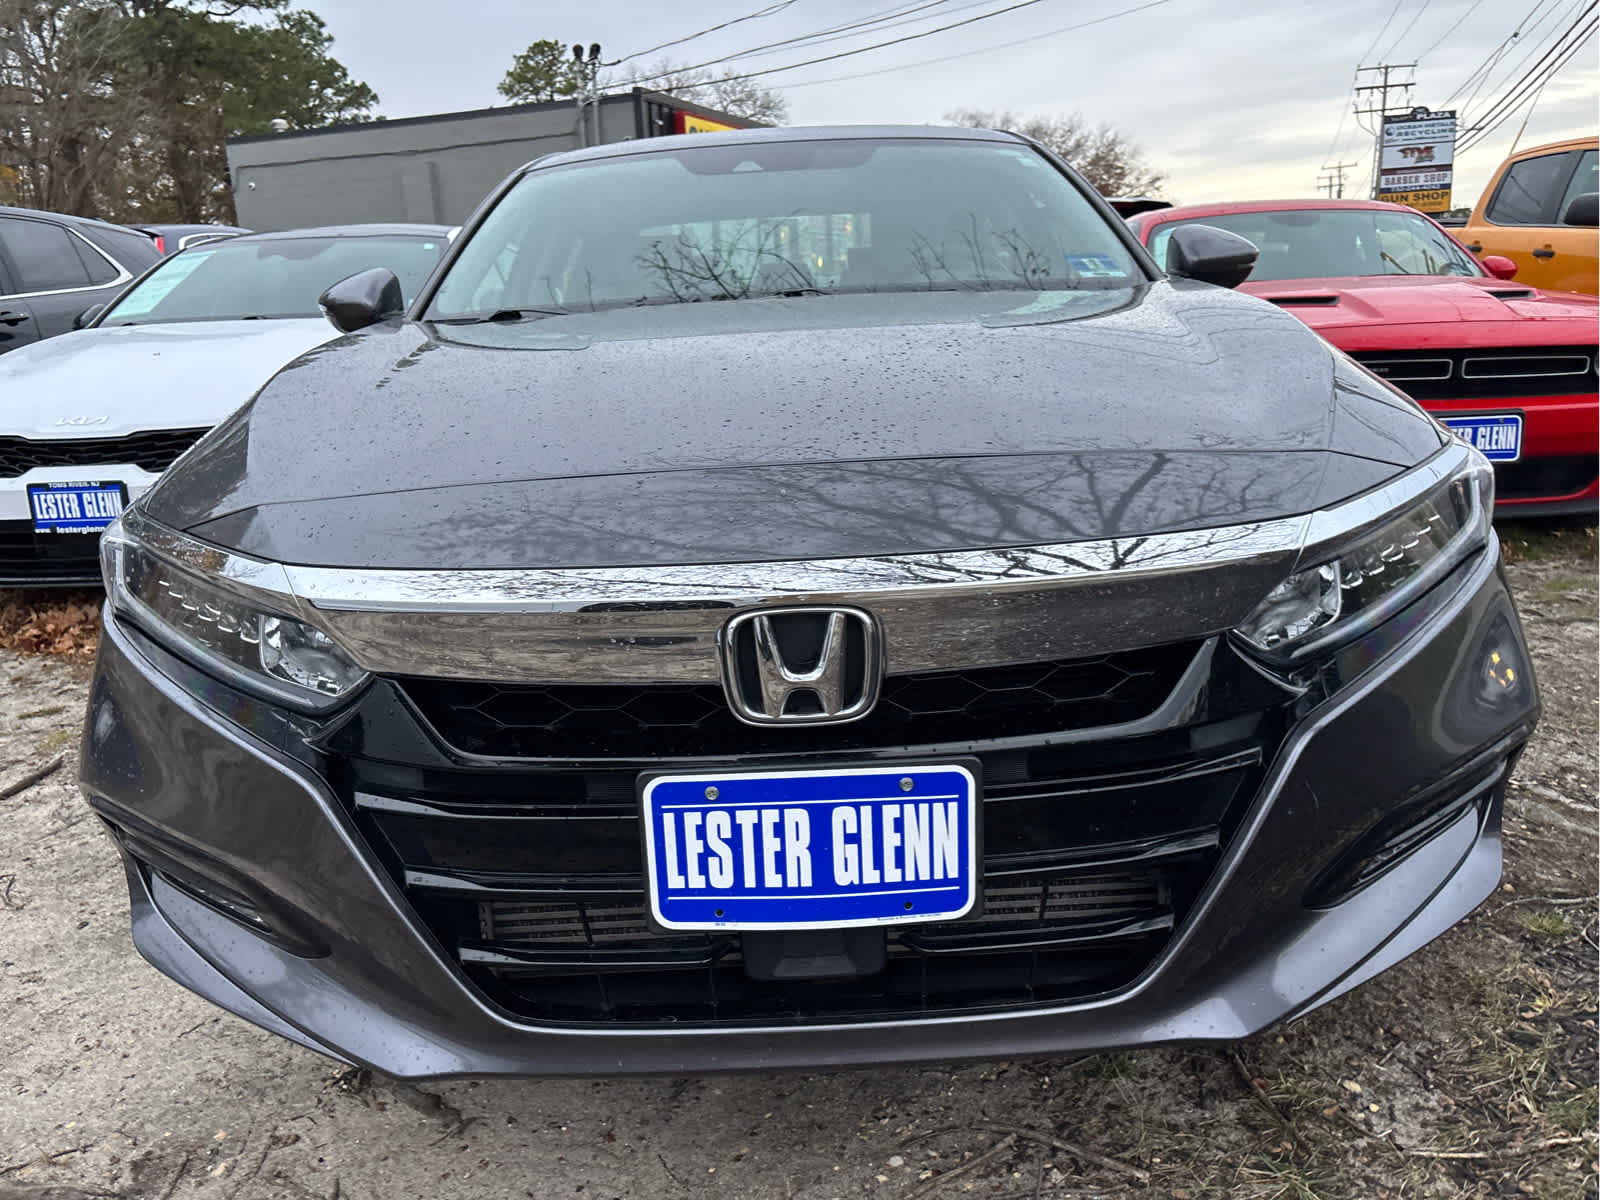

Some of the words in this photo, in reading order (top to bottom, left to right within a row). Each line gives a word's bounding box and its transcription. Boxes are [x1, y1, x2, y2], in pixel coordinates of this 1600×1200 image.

[1396, 127, 1455, 137] RECYCLING
[1384, 175, 1420, 186] BARBER
[1423, 173, 1448, 183] SHOP
[1380, 193, 1409, 203] GUN
[1413, 191, 1449, 201] SHOP
[1476, 425, 1517, 450] GLENN
[33, 493, 81, 519] LESTER
[82, 491, 123, 518] GLENN
[662, 808, 813, 889] LESTER
[832, 801, 959, 887] GLENN
